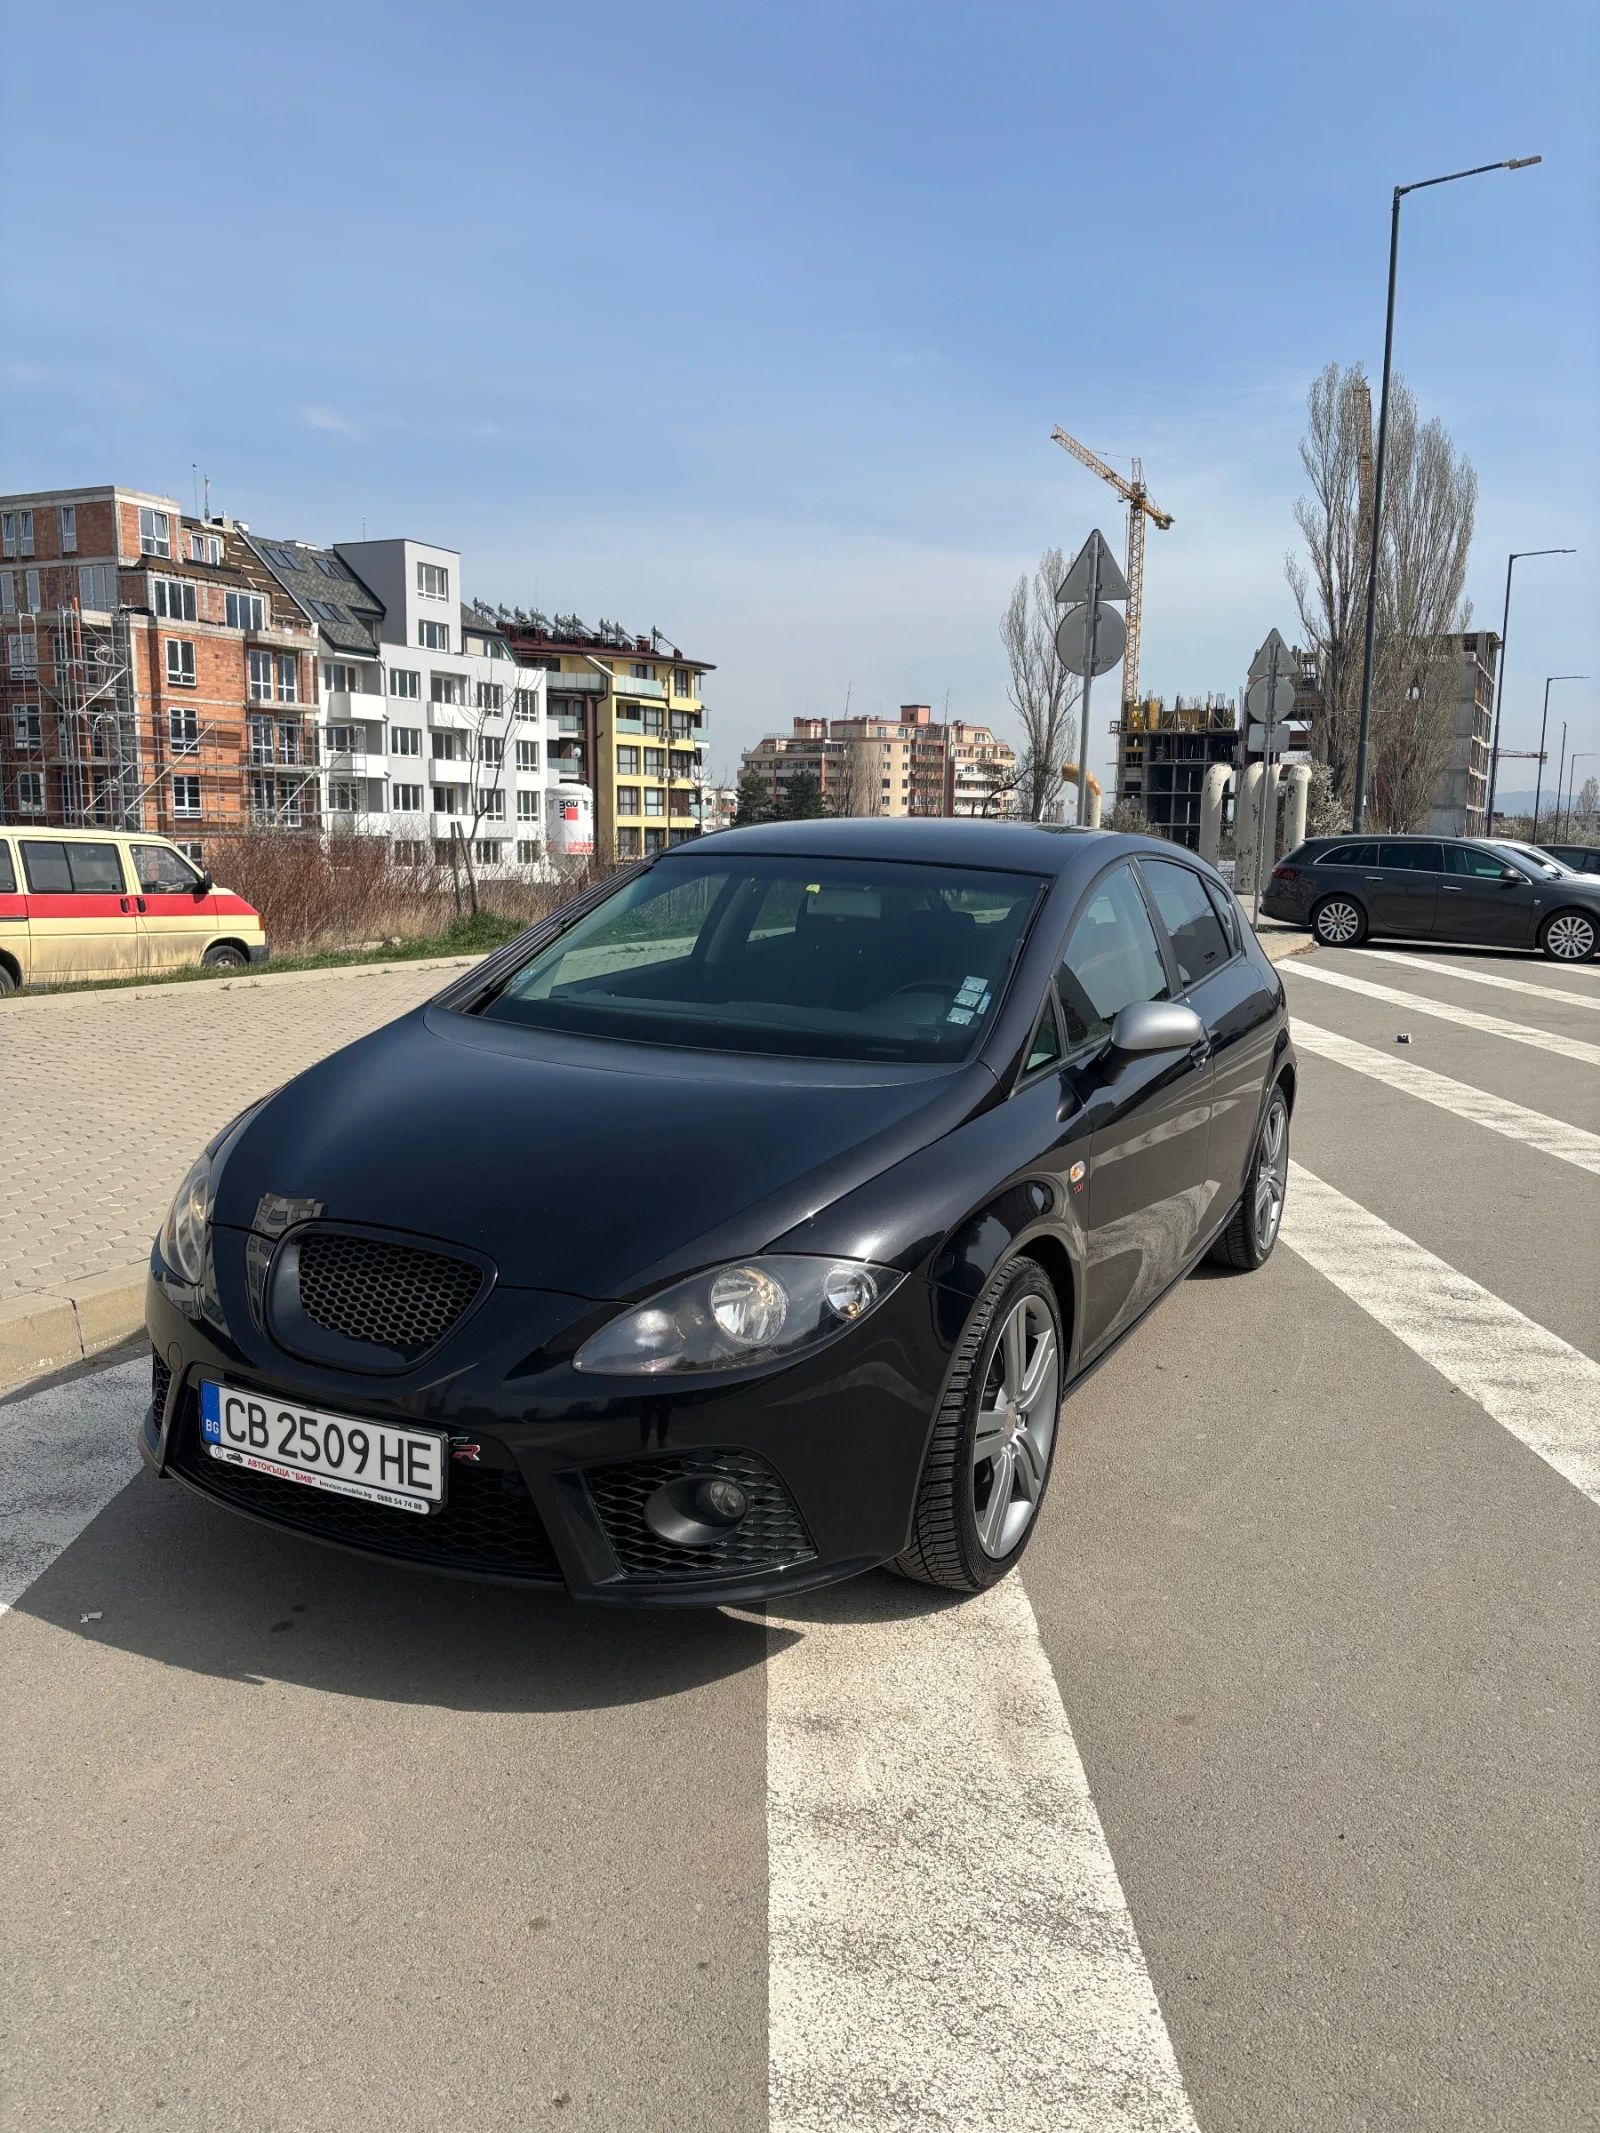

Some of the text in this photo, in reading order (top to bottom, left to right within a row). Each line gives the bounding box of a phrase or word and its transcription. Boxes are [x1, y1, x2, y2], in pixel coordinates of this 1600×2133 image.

[205, 1419, 219, 1434] BG
[225, 1397, 433, 1491] CB 2509 HE
[247, 1458, 290, 1478] АВТОКЪЩА
